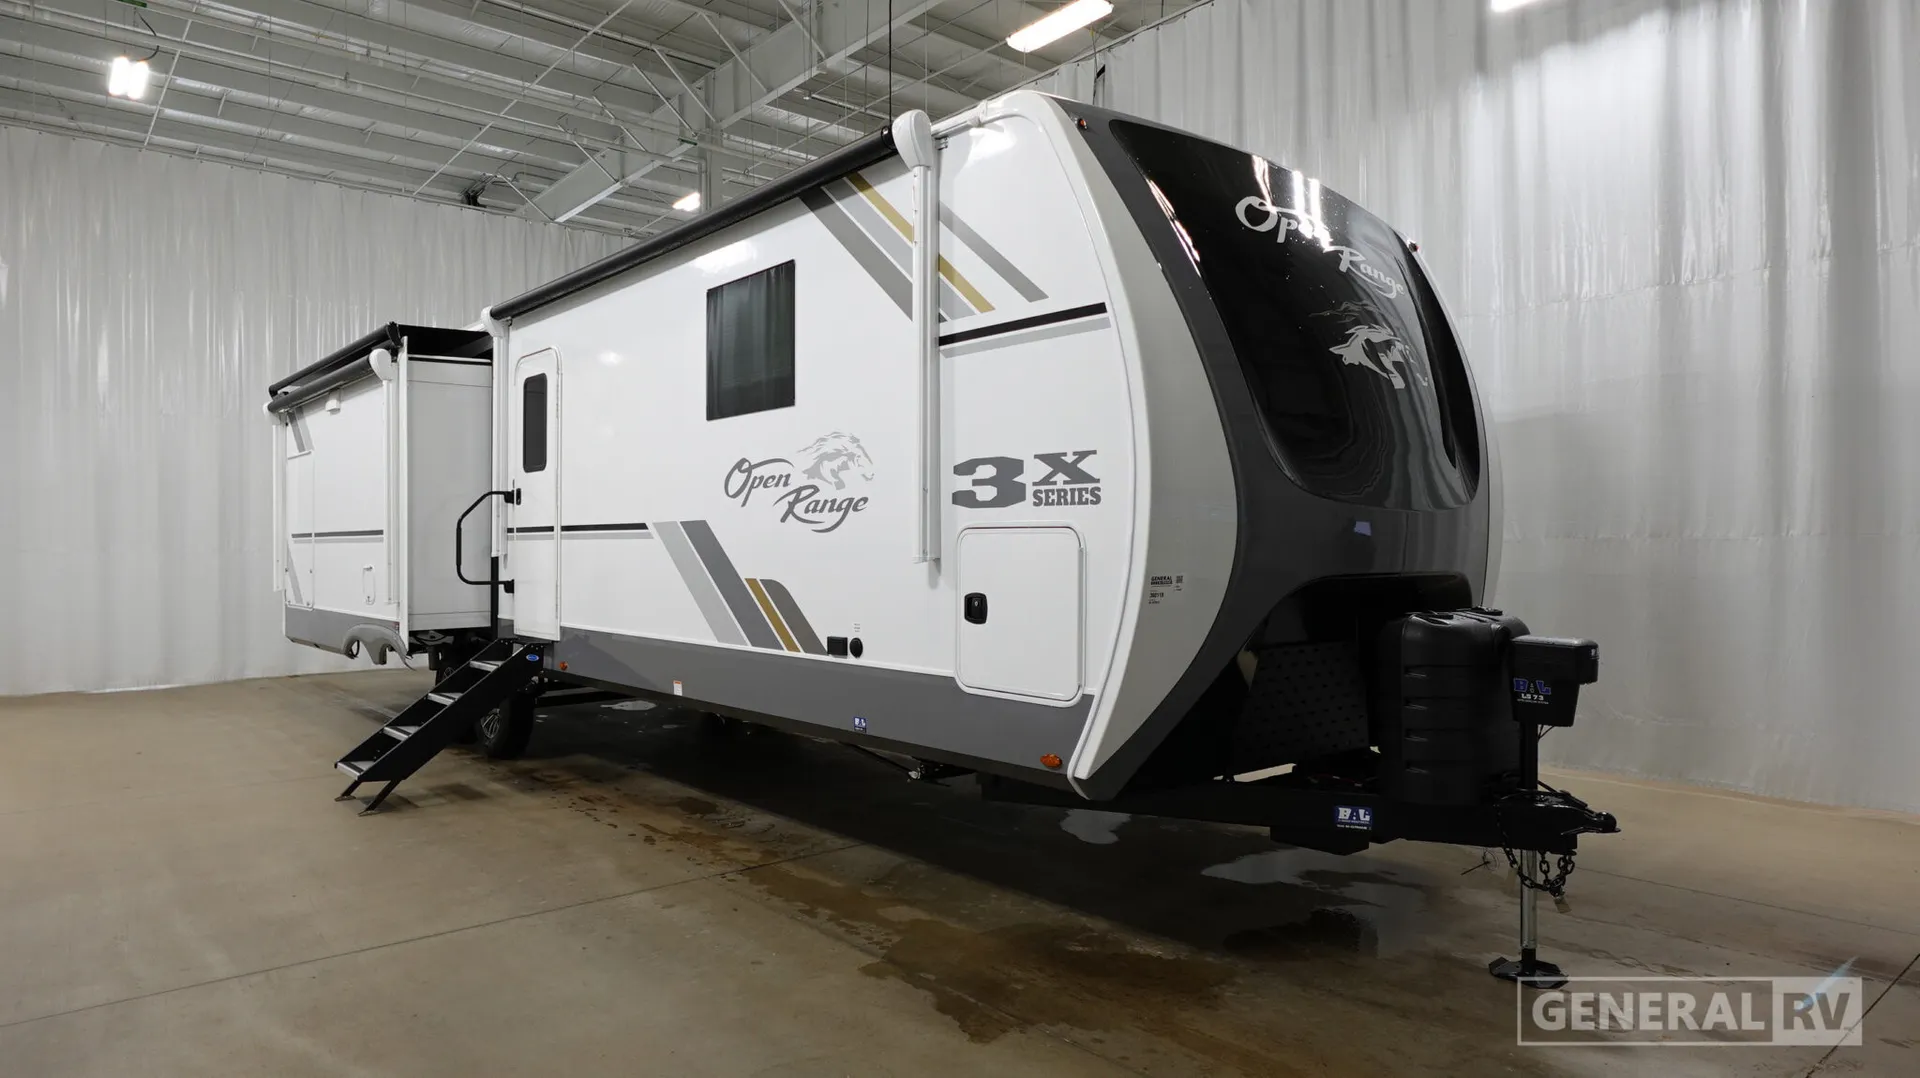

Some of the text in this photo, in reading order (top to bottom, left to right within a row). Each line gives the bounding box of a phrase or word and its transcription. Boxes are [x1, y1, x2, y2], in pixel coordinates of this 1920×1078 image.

[1235, 195, 1331, 243] Op
[1323, 246, 1405, 299] Range
[724, 457, 795, 508] Open
[1032, 486, 1102, 508] SERIES
[773, 484, 869, 533] Range
